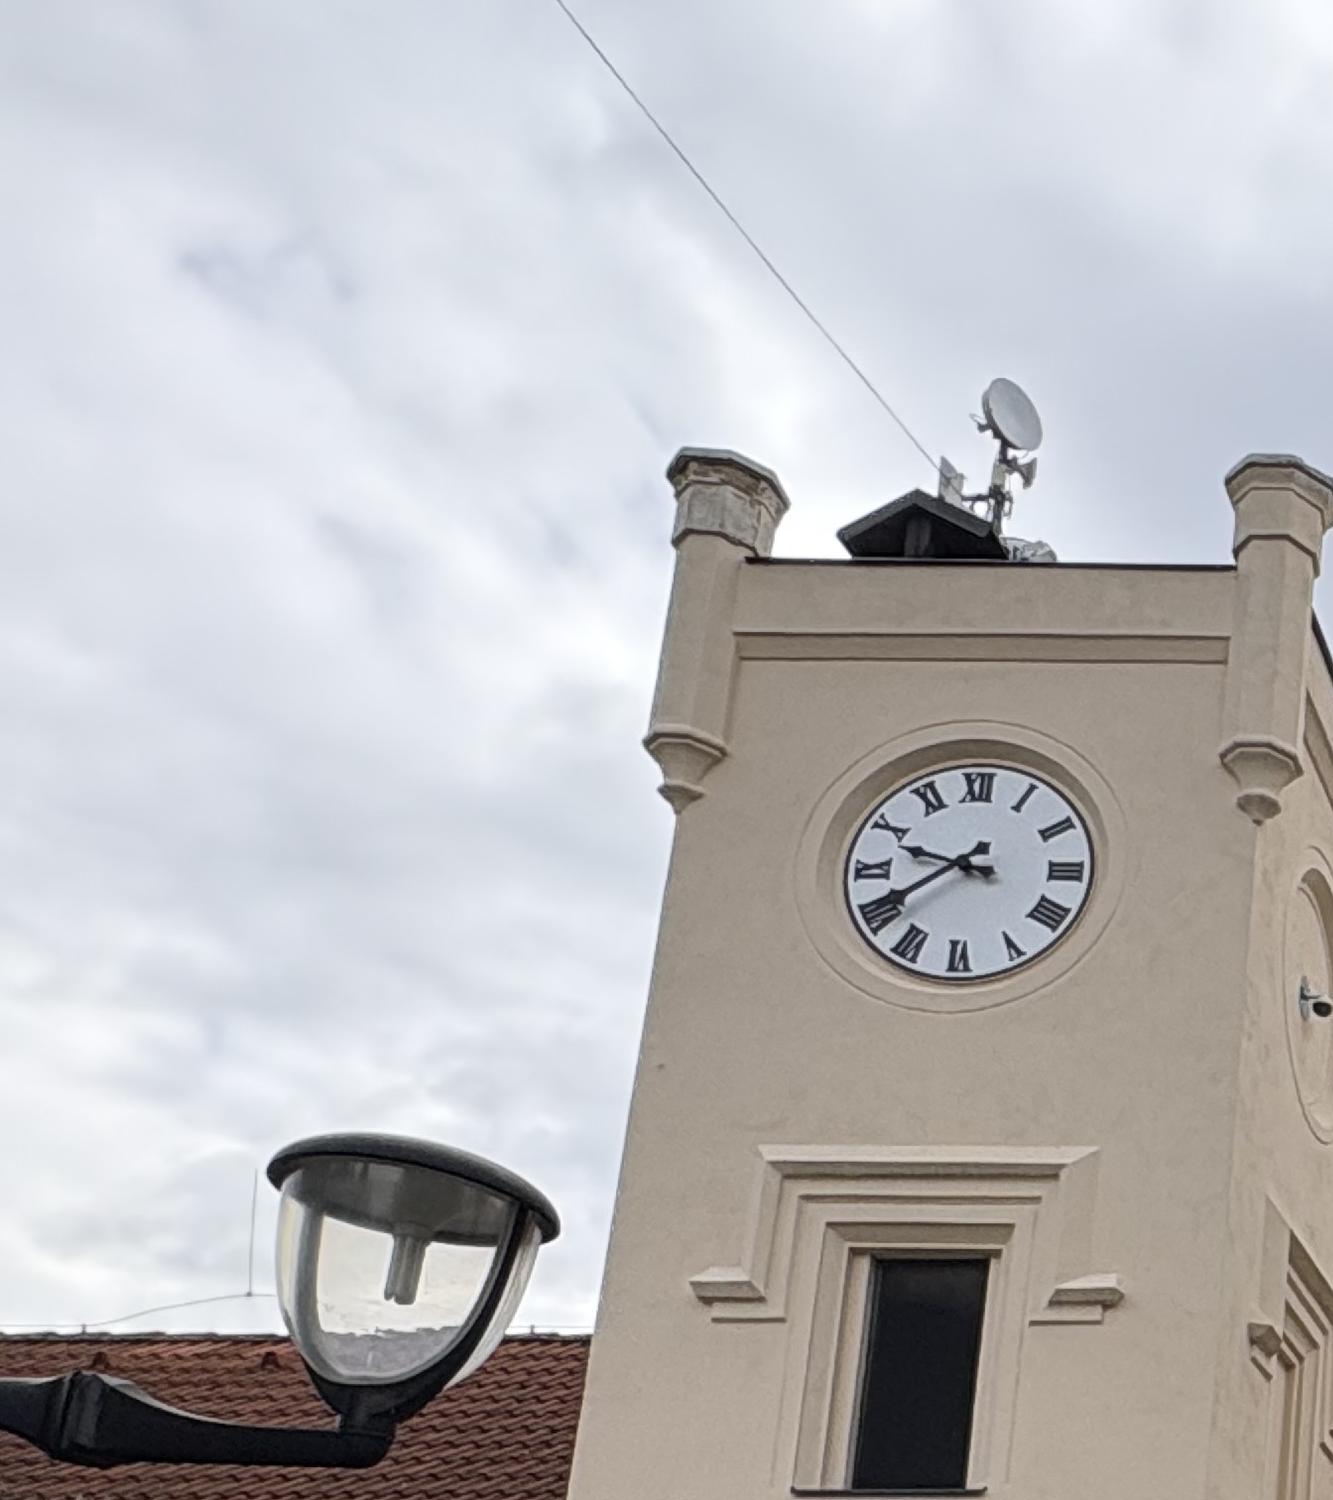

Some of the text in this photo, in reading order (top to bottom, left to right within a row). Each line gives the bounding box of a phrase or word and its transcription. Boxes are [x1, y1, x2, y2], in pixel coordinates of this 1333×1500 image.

[910, 780, 949, 817] XI
[958, 772, 997, 803] XII
[1010, 783, 1039, 813] I
[870, 812, 911, 842] X
[1037, 815, 1077, 843] II
[854, 857, 893, 882] IX
[1046, 860, 1084, 883] III
[1025, 894, 1072, 933] IIII
[946, 939, 973, 973] VI
[1001, 930, 1027, 962] V
